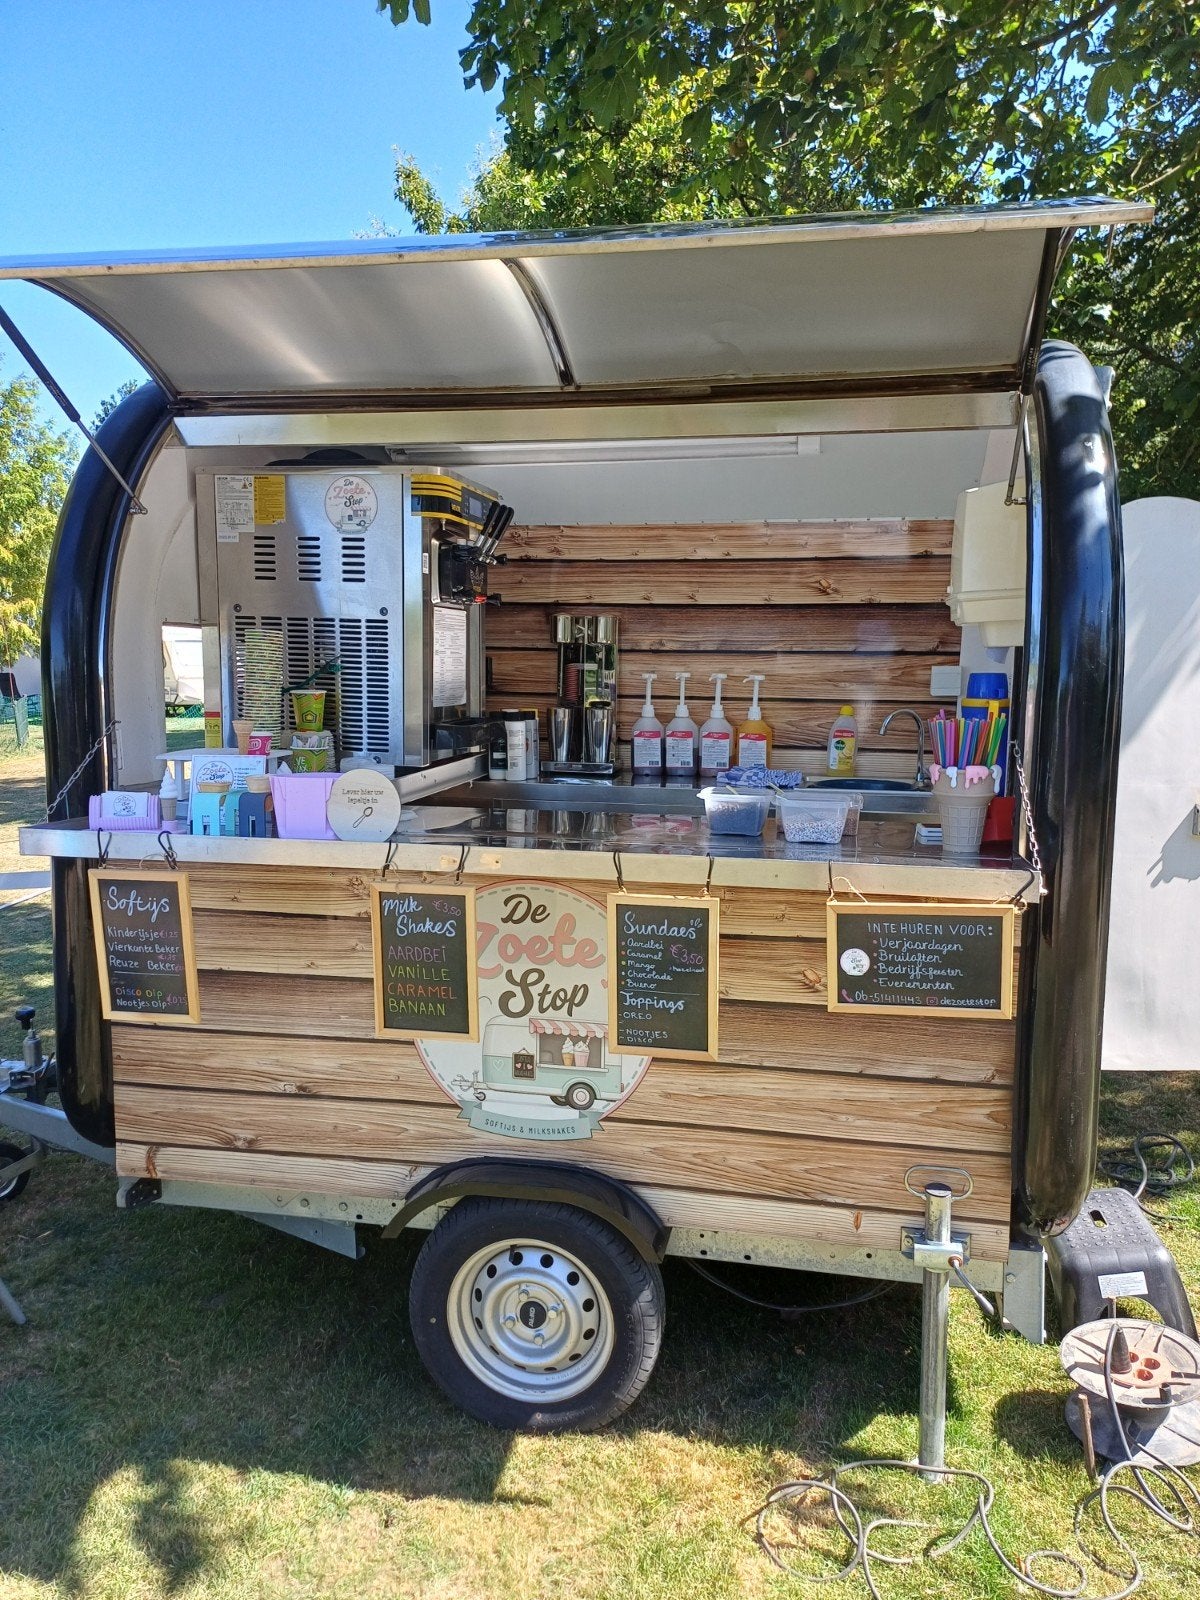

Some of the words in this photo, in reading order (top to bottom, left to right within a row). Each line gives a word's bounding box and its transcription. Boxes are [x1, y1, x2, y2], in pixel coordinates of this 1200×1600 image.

[106, 886, 170, 923] Softijs
[382, 895, 423, 916] Milk
[500, 893, 550, 925] De
[107, 925, 160, 941] Kinderijsje
[396, 914, 457, 937] Shakes
[623, 910, 697, 940] Sundaes
[900, 922, 943, 935] HUREN
[155, 943, 180, 954] Beker
[476, 912, 606, 979] Zoete
[879, 937, 964, 956] Verjaardagen
[109, 955, 139, 968] Reuze
[147, 959, 175, 971] Beker
[626, 949, 663, 961] Caramel
[627, 960, 656, 974] Mango
[627, 969, 673, 981] Chocolade
[877, 962, 964, 980] Bedrijfsfeesten
[115, 986, 142, 997] Disco
[387, 981, 458, 1000] CARAMEL
[626, 978, 657, 989] Bueno
[878, 977, 955, 990] Evenementen
[498, 967, 588, 1019] Stop
[116, 998, 150, 1010] Nootjes
[388, 998, 446, 1016] BANAAN
[619, 990, 685, 1014] Toppings
[623, 1011, 653, 1020] OREO
[626, 1027, 669, 1039] NOOTJES
[484, 1118, 516, 1132] SOFTIJS
[528, 1126, 576, 1136] MILKSHAKES
